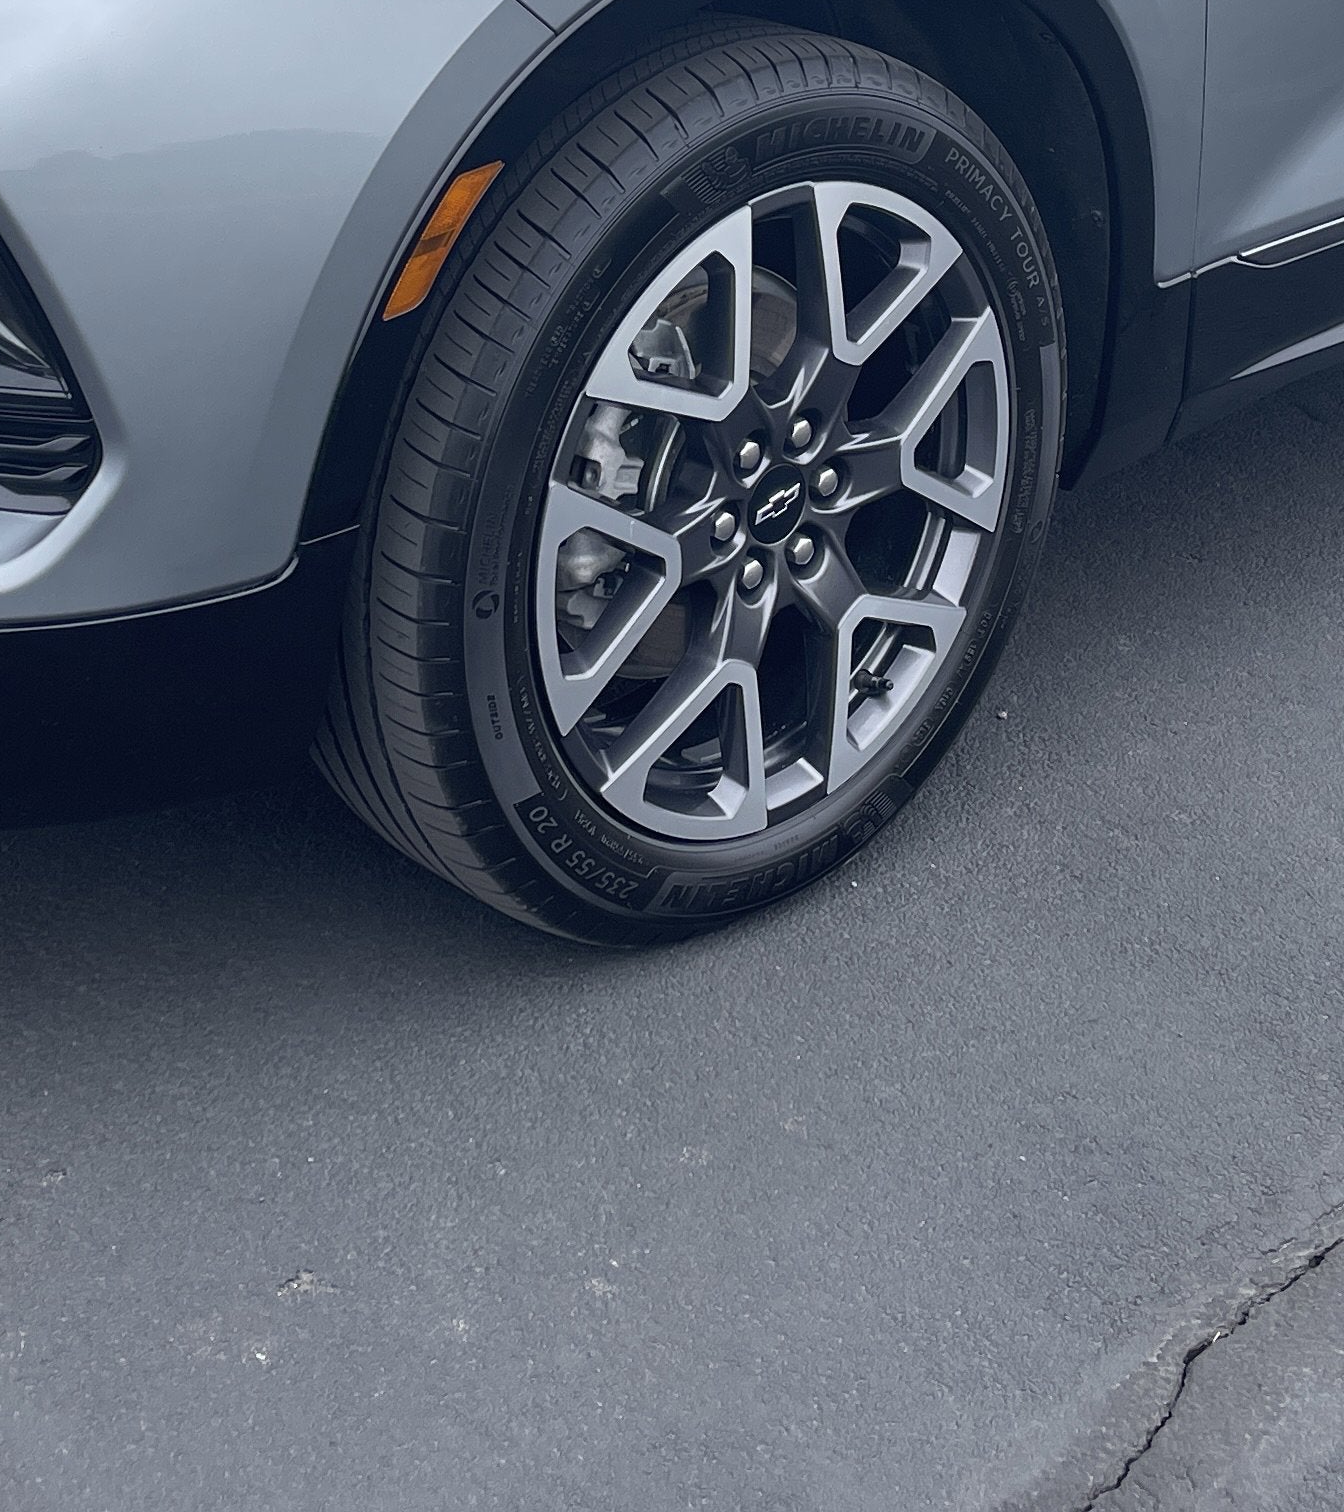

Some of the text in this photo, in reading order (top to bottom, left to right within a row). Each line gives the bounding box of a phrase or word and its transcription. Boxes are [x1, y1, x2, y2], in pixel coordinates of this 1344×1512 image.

[756, 116, 927, 161] MICHELIN
[945, 147, 1012, 222] PRIMACY
[1010, 226, 1040, 288] TOUR
[486, 694, 504, 741] OUTSIDE
[529, 806, 558, 834] 20
[550, 834, 573, 854] R
[565, 850, 639, 899] 235/55
[658, 833, 840, 908] MICHELIN
